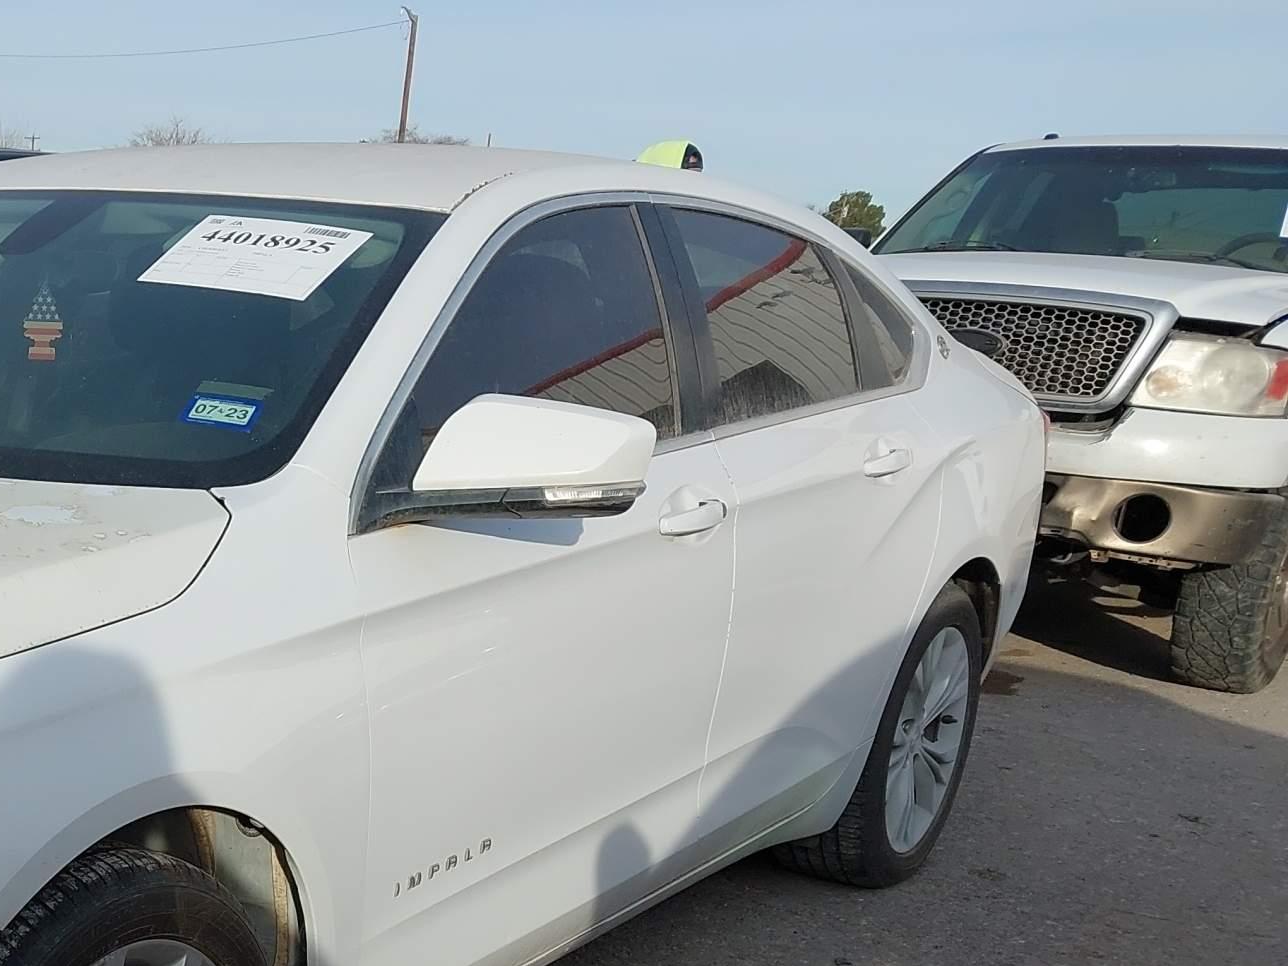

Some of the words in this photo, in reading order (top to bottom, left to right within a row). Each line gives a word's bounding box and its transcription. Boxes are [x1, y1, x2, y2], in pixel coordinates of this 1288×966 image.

[200, 229, 338, 255] 44018925
[194, 403, 219, 414] 07
[224, 407, 249, 420] 23
[393, 838, 492, 898] IMPALA
